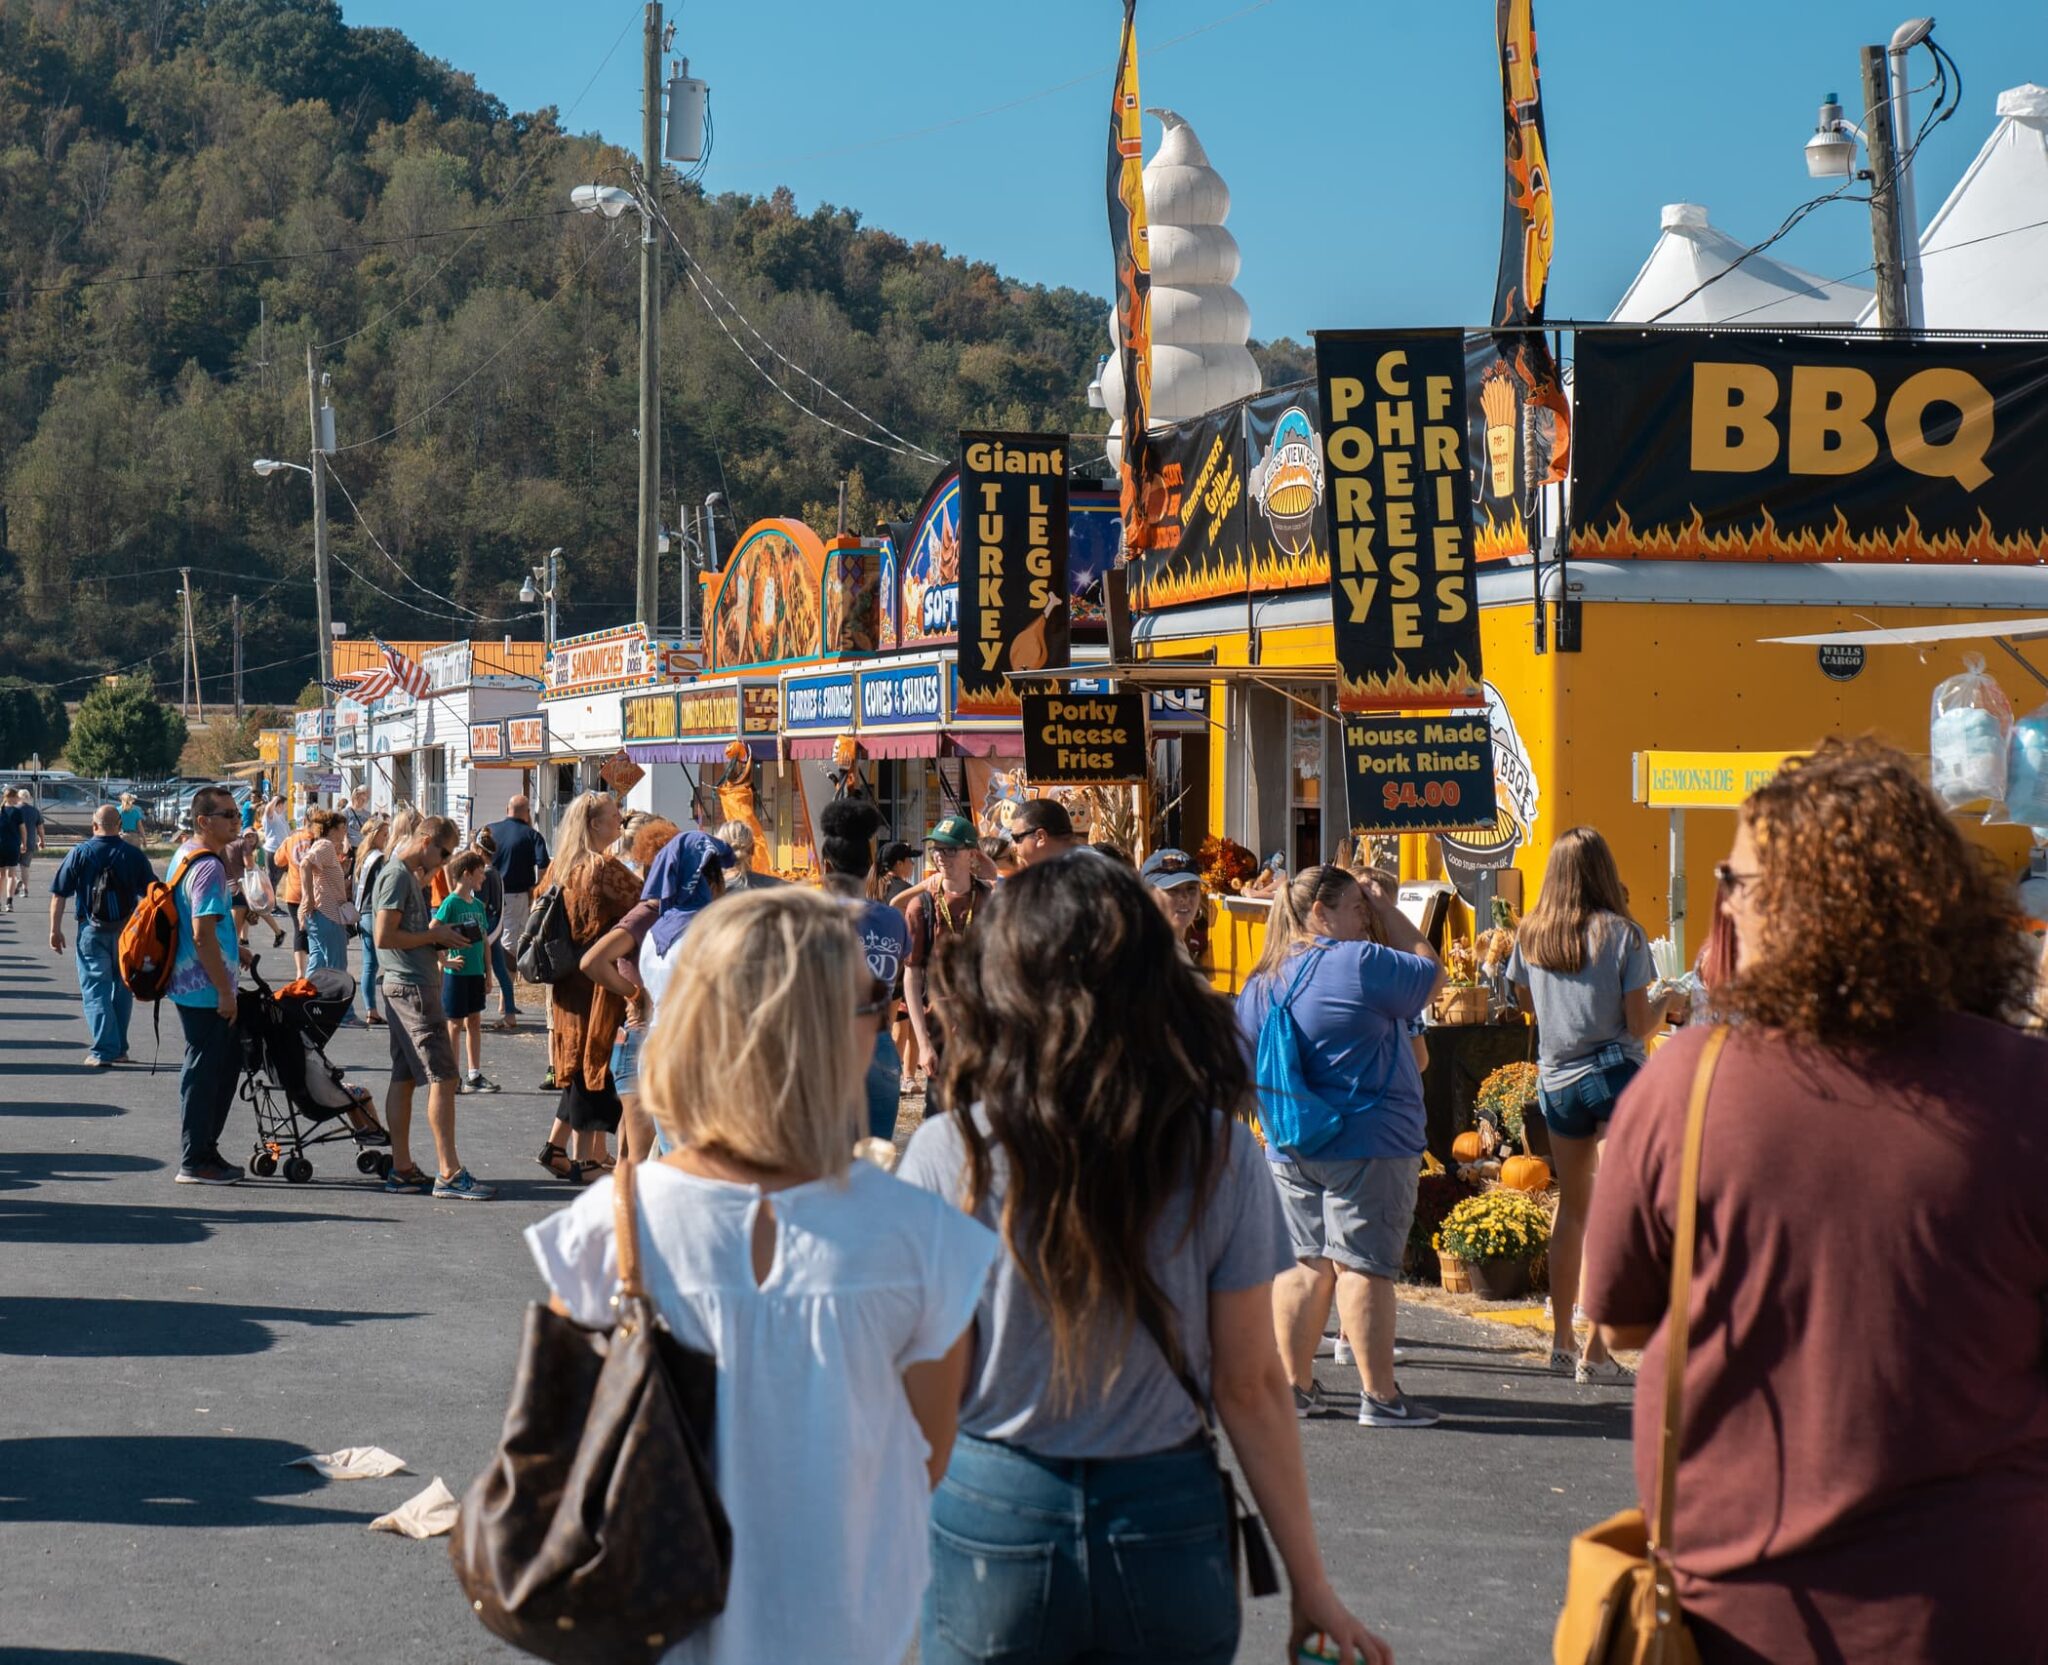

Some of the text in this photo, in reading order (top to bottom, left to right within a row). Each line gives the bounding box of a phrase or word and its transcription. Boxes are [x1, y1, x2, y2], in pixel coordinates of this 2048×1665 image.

[1690, 362, 1995, 493] BBQ
[966, 441, 1064, 476] Giant
[1285, 446, 1306, 463] VIEW
[1181, 434, 1223, 526] Hamburgers
[1327, 377, 1379, 623] PORKY
[1375, 350, 1424, 648] CHEESE
[1423, 375, 1468, 623] FRIES
[1026, 485, 1052, 609] LEGS
[978, 482, 1004, 671] TURKEY
[629, 640, 639, 656] HOT
[1822, 656, 1860, 665] CARGO
[1823, 647, 1861, 656] WELLS
[571, 645, 624, 681] SANDWICHES
[627, 657, 641, 673] DOGS
[744, 688, 778, 702] TA
[865, 675, 938, 717] CONES & SHAKES
[1048, 701, 1118, 725] Porky
[1041, 724, 1127, 745] Cheese
[1347, 722, 1488, 747] House Made
[1057, 748, 1114, 769] Fries
[1358, 752, 1411, 774] Pork
[1416, 751, 1481, 772] Rinds
[1500, 752, 1526, 794] BBQ
[1653, 768, 1777, 792] LEMONADE ICE
[1382, 780, 1461, 810] $4.00
[1448, 853, 1463, 867] GOOD
